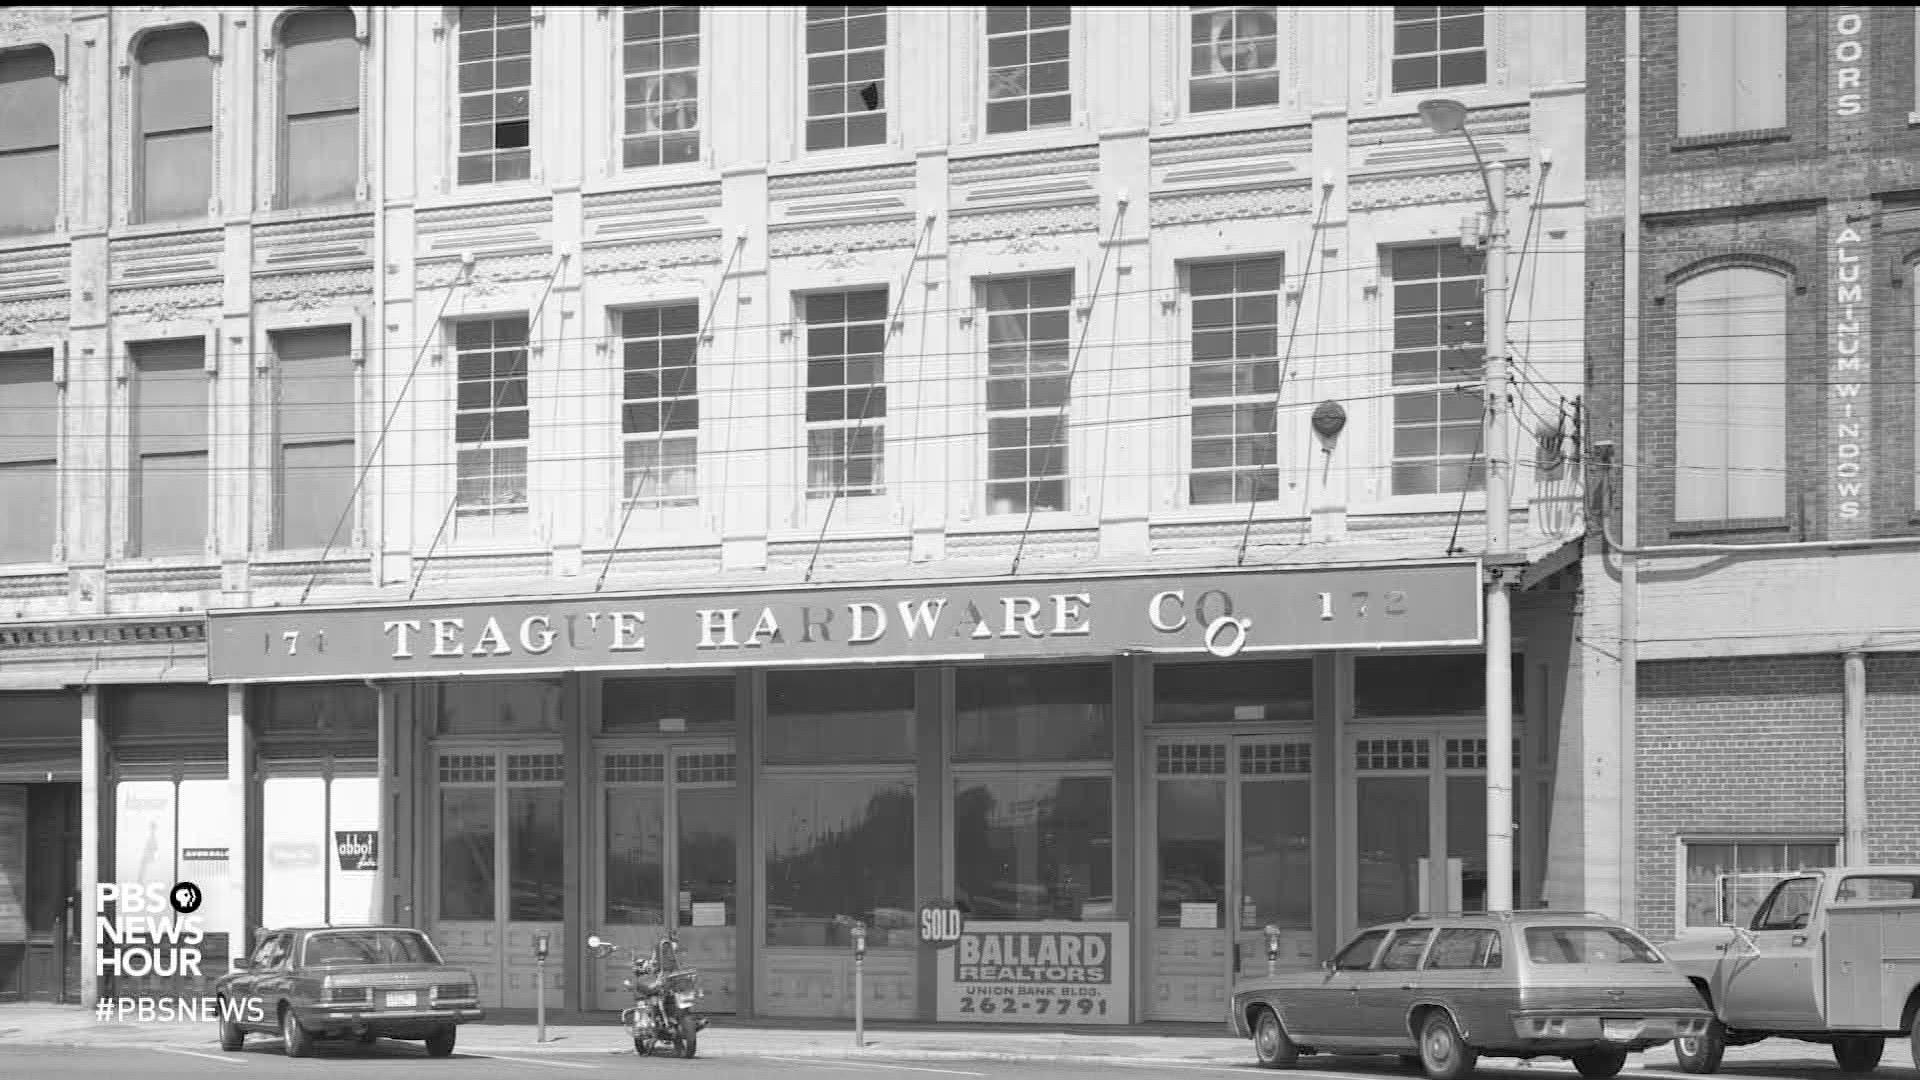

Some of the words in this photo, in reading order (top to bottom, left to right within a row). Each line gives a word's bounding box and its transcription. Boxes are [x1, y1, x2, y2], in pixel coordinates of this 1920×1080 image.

[1835, 228, 1862, 371] ALUMINUM
[1836, 383, 1862, 518] WINDOWS
[383, 610, 647, 660] TEAGUE
[695, 592, 1092, 650] HARDWARE
[921, 908, 961, 941] SOLD
[959, 934, 1106, 966] BALLARD
[959, 966, 1105, 982] REALTORS
[959, 997, 1107, 1015] 262-7791
[967, 985, 1014, 996] UNION
[1017, 986, 1057, 997] BANK
